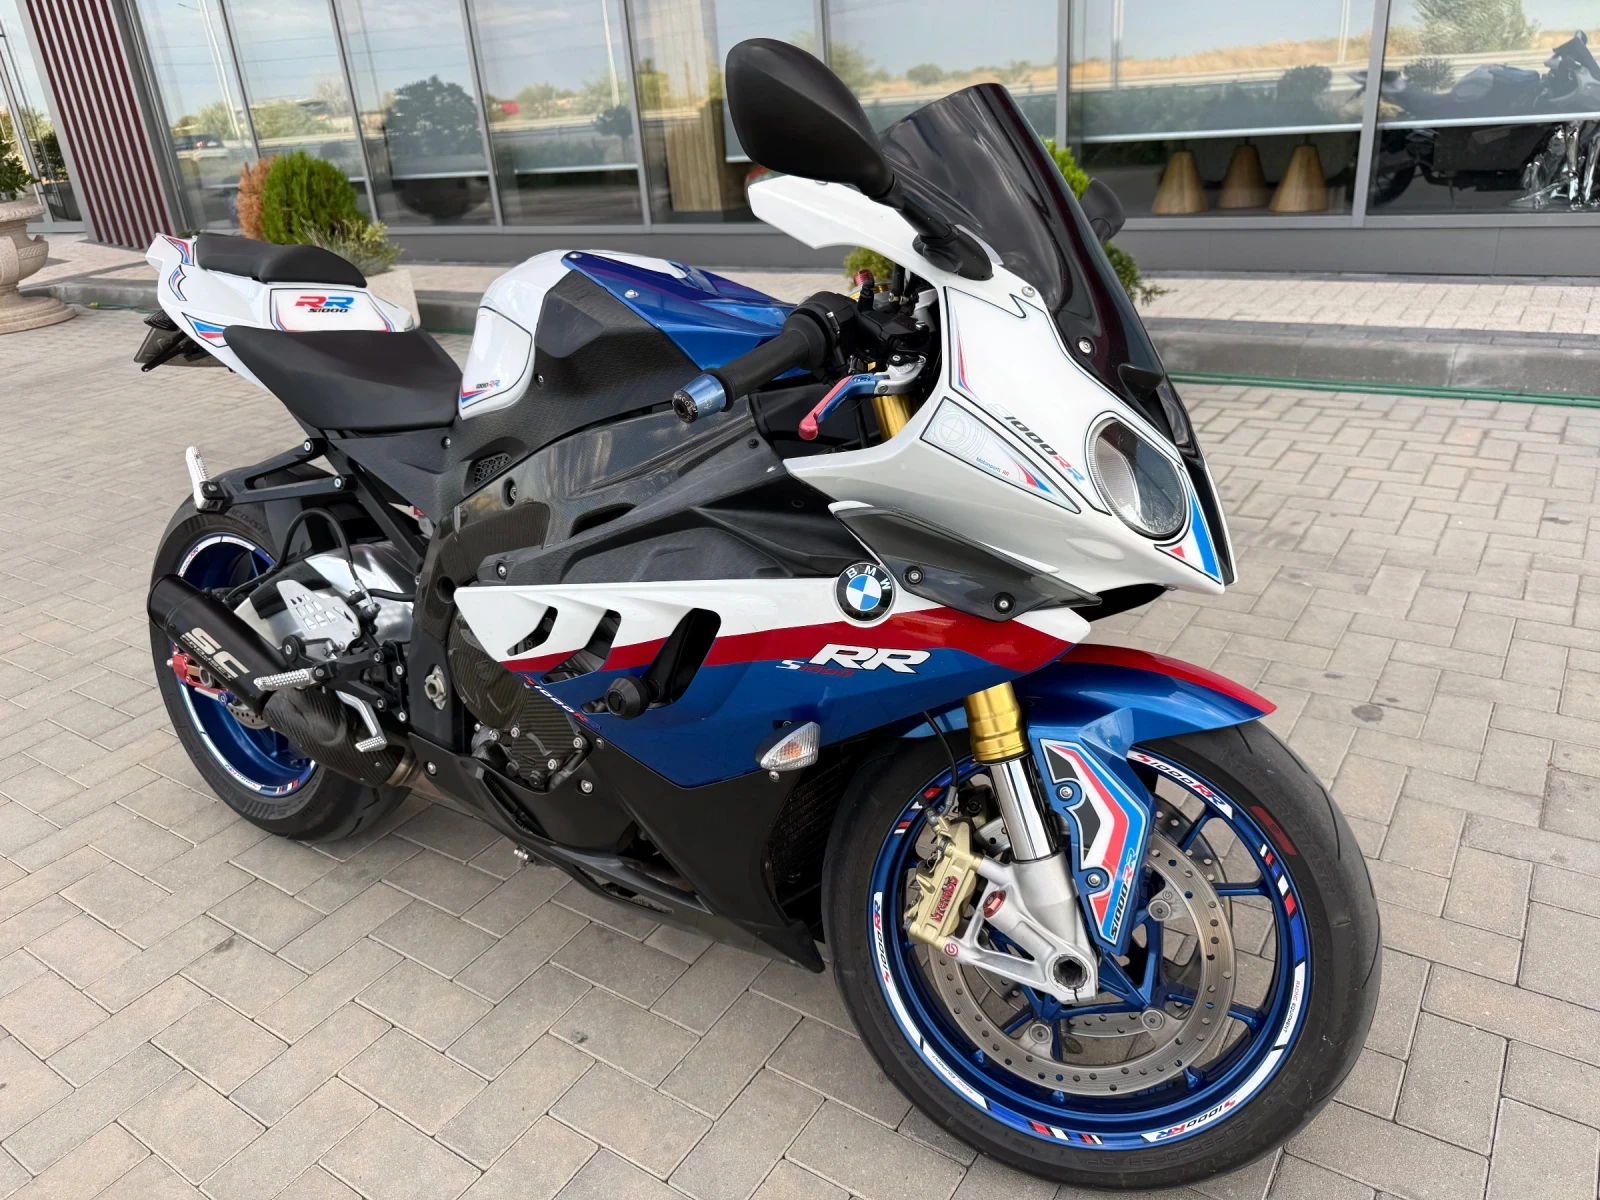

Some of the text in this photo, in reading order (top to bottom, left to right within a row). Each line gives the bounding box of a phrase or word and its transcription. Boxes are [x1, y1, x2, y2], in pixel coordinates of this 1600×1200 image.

[295, 296, 354, 309] RR
[1002, 469, 1010, 477] RR
[846, 565, 891, 591] BMW
[184, 627, 250, 678] SC
[776, 643, 932, 678] S1000 RR
[1136, 752, 1226, 807] S1000RR
[1268, 822, 1281, 835] SP
[930, 876, 959, 923] brembo
[1110, 847, 1137, 940] S1000RR
[872, 899, 891, 984] S1000RR
[1155, 1094, 1238, 1140] S1000RR
